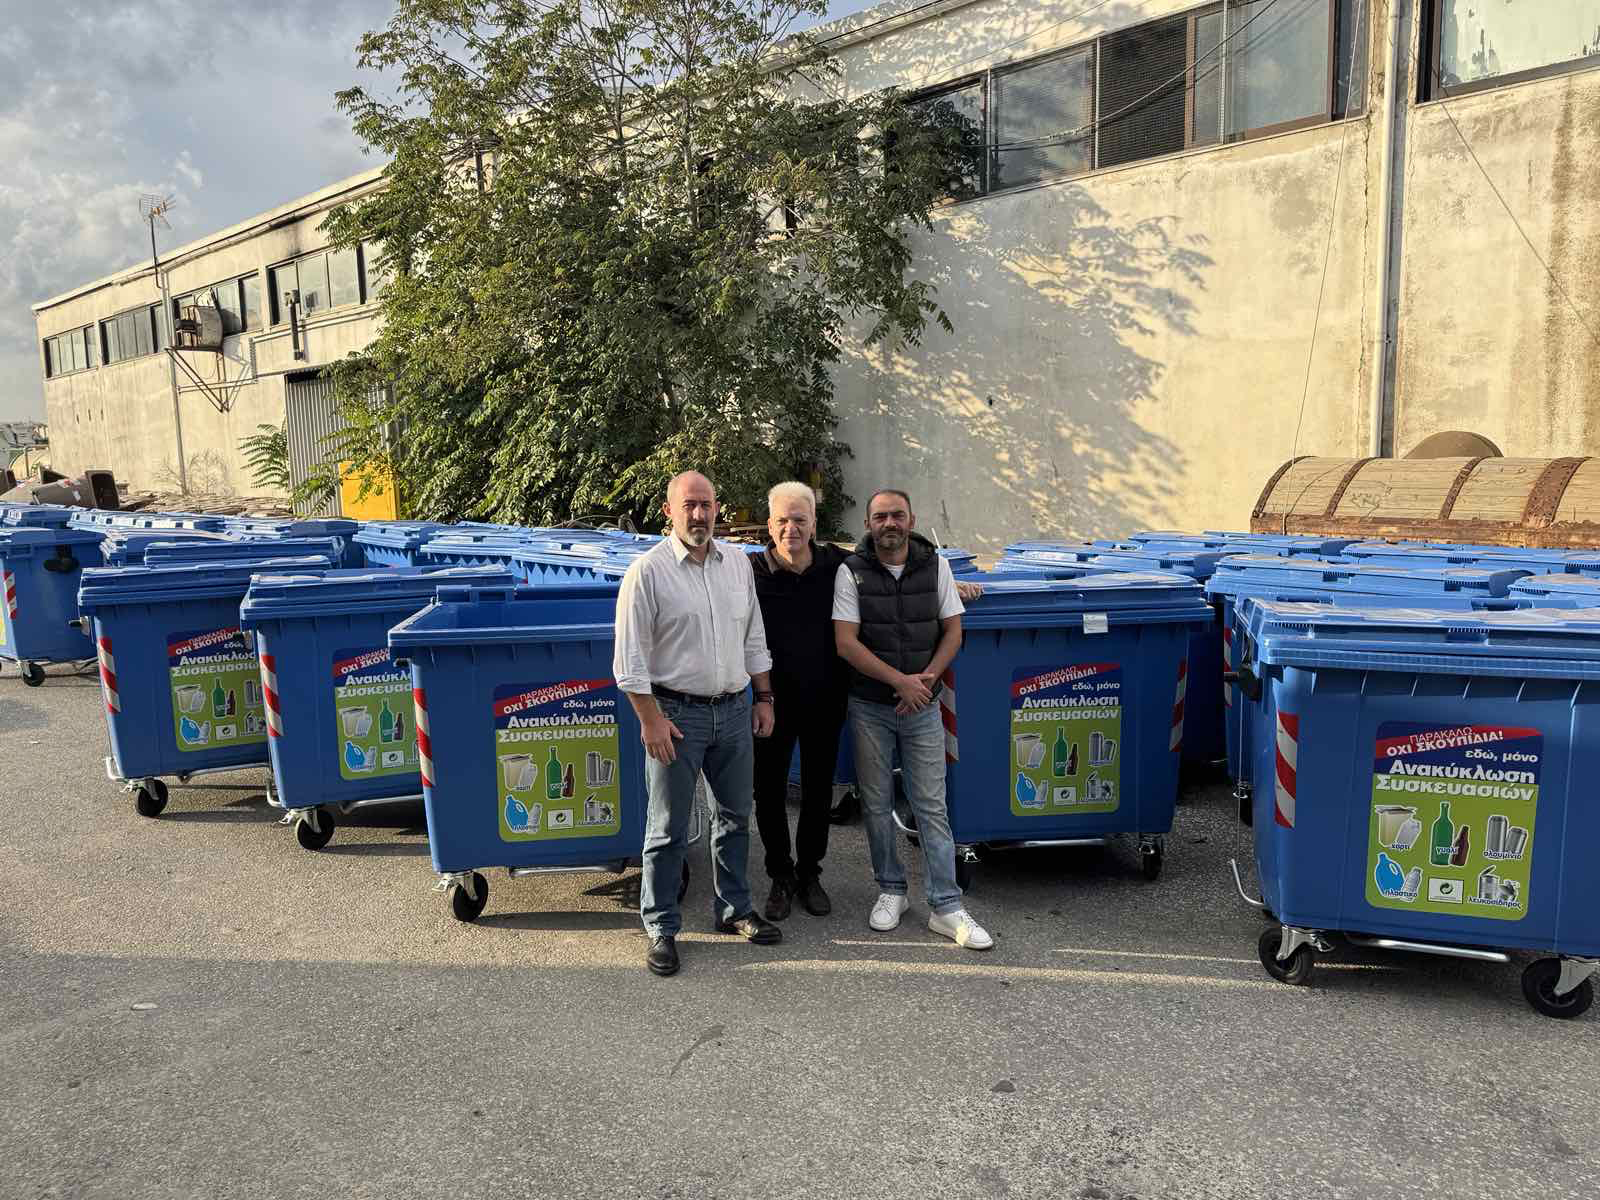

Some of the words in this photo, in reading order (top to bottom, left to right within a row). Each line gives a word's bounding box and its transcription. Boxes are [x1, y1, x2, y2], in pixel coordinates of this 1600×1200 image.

[175, 645, 192, 655] ΟΧΙ
[180, 651, 256, 666] Ανακύκλωσ
[341, 663, 359, 674] ΟΧΙ
[345, 670, 412, 686] Ανακύκλ
[1019, 683, 1037, 695] ΟΧΙ
[1097, 681, 1121, 691] μόνο
[503, 701, 524, 714] ΟΧΙ
[590, 698, 615, 709] μόνο
[1022, 695, 1119, 709] Ανακύκλωση
[507, 713, 615, 729] Ανακύκλωση
[1013, 706, 1119, 722] Συσκευασιών
[497, 725, 616, 743] Συσκευασιών
[1386, 743, 1413, 757] ΟΧΙ
[1465, 749, 1498, 761] εδώ,
[1502, 751, 1538, 763] μόνο
[1389, 759, 1536, 784] Ανακύκλωση
[1375, 774, 1535, 801] Συσκευασιών
